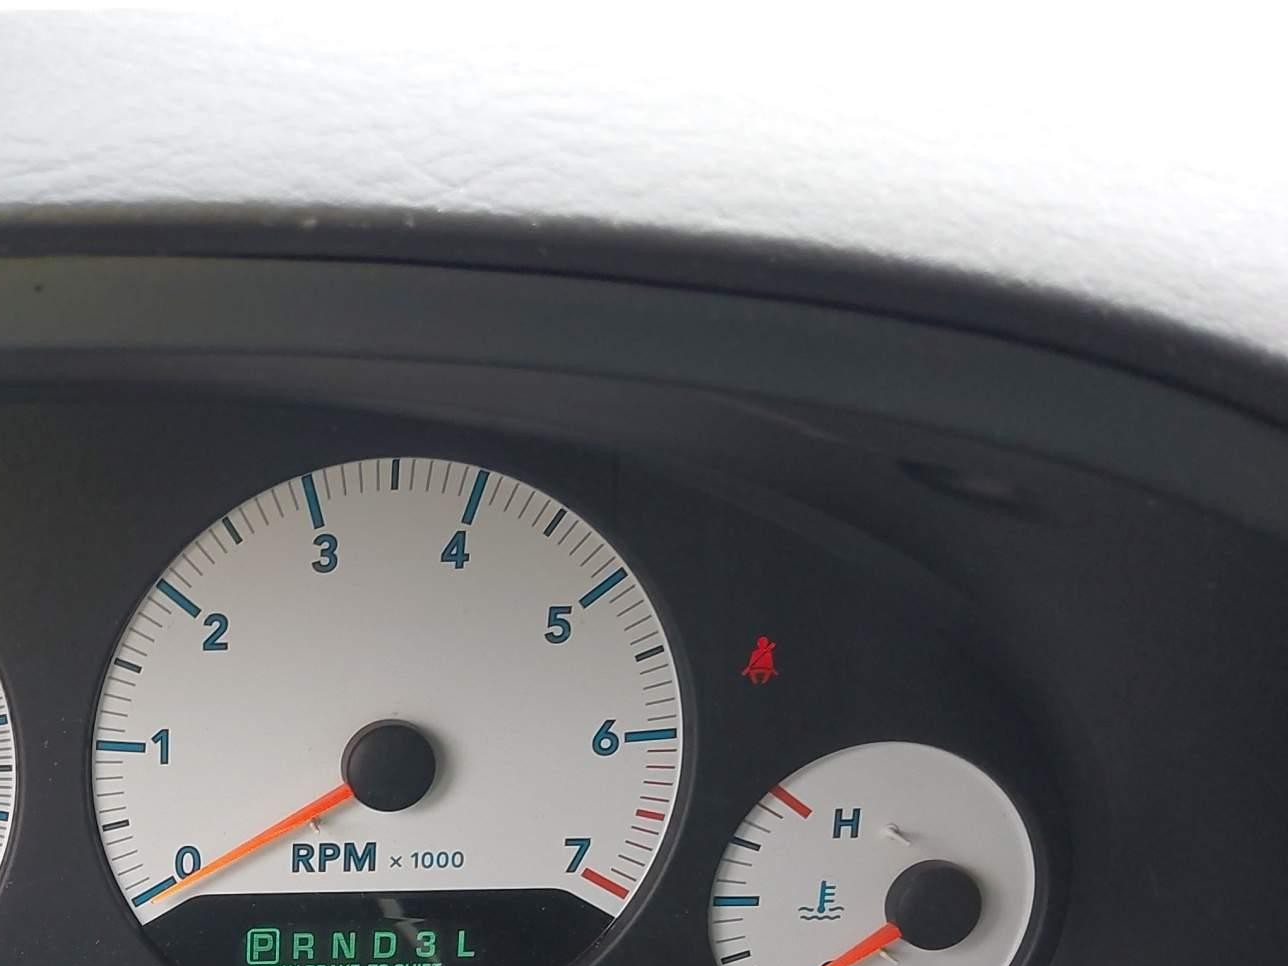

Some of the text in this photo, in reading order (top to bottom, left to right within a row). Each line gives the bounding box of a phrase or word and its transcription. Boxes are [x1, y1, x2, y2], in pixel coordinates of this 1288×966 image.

[312, 534, 339, 574] 3
[441, 531, 470, 569] 4
[202, 614, 229, 651] 2
[544, 606, 572, 644] 5
[151, 729, 169, 764] 1
[592, 720, 619, 757] 6
[833, 808, 861, 838] H
[175, 846, 201, 880] 0
[291, 842, 377, 873] RPM
[410, 851, 464, 869] 1000
[565, 838, 591, 872] 7
[253, 931, 475, 960] P R N D 3 L
